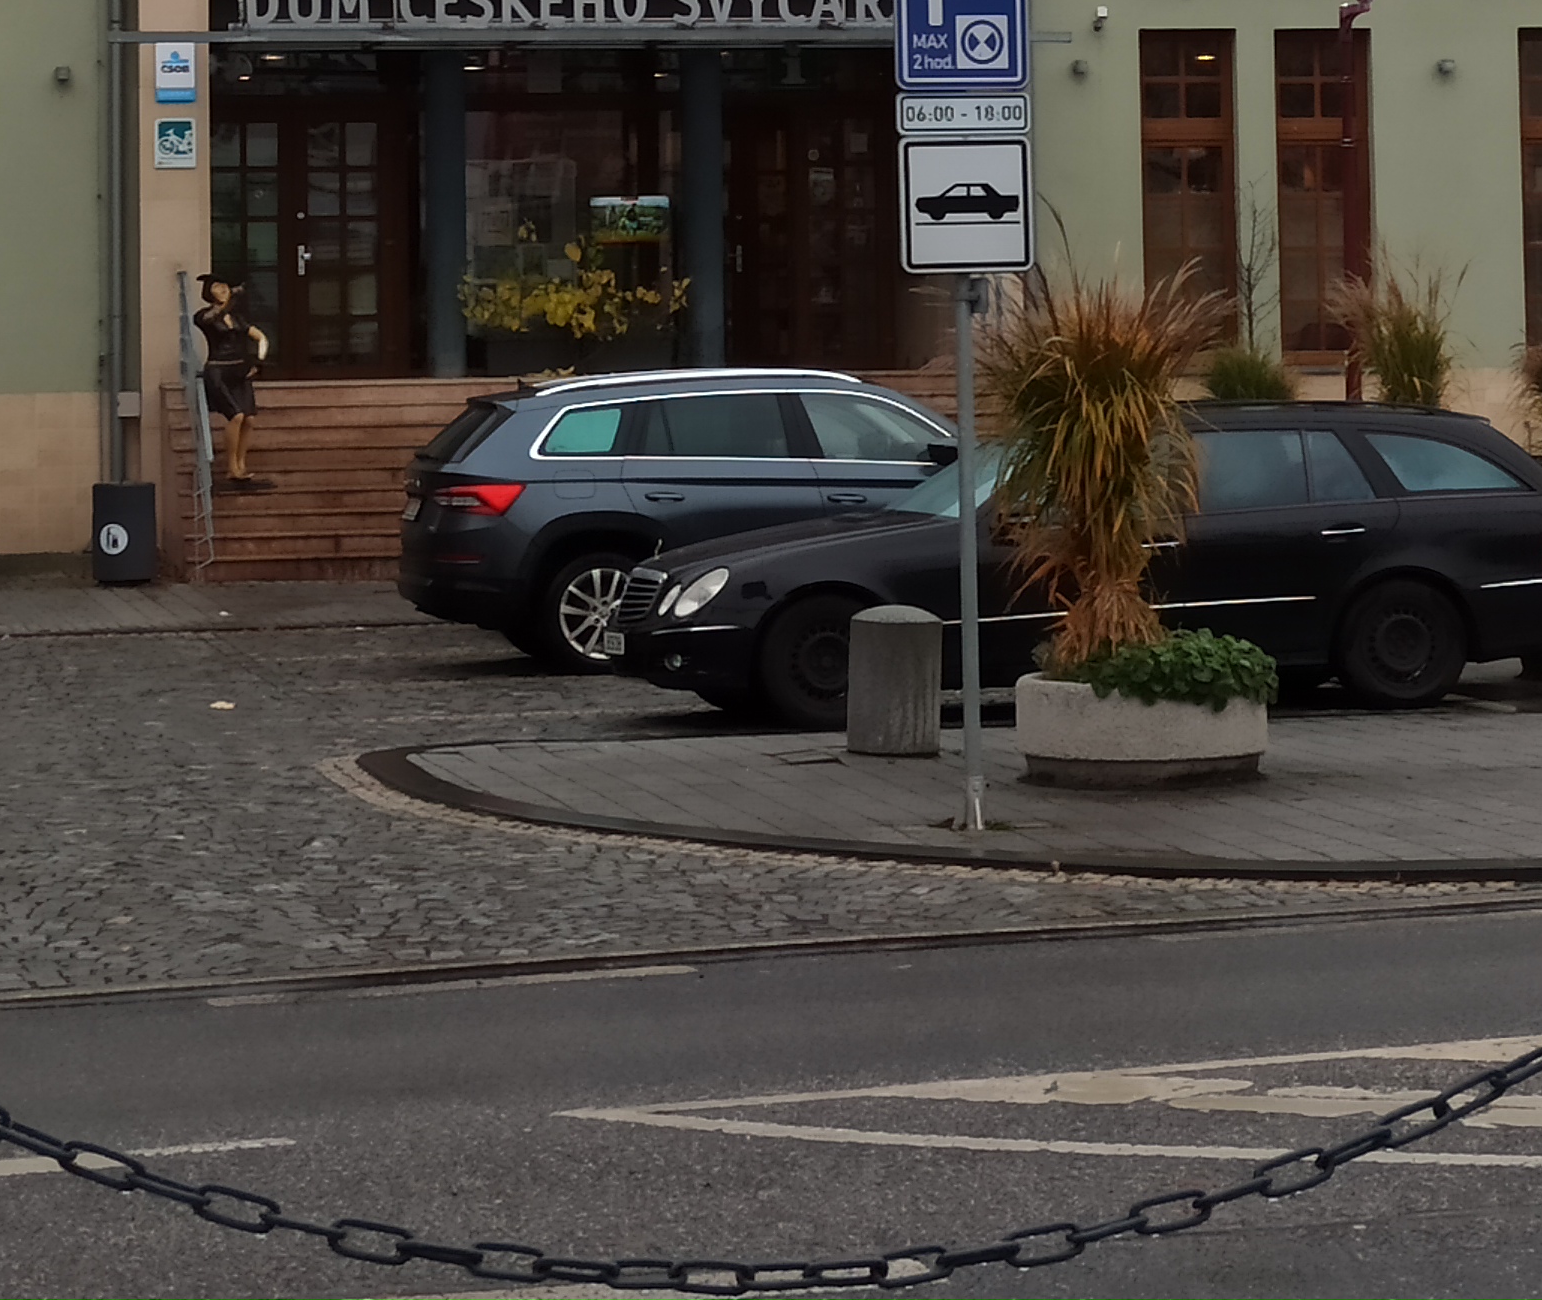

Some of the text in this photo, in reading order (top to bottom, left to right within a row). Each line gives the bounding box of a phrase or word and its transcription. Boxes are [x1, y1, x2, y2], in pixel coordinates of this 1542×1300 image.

[912, 32, 949, 49] MAX
[905, 105, 955, 122] 06:00
[974, 104, 1022, 122] 18:00
